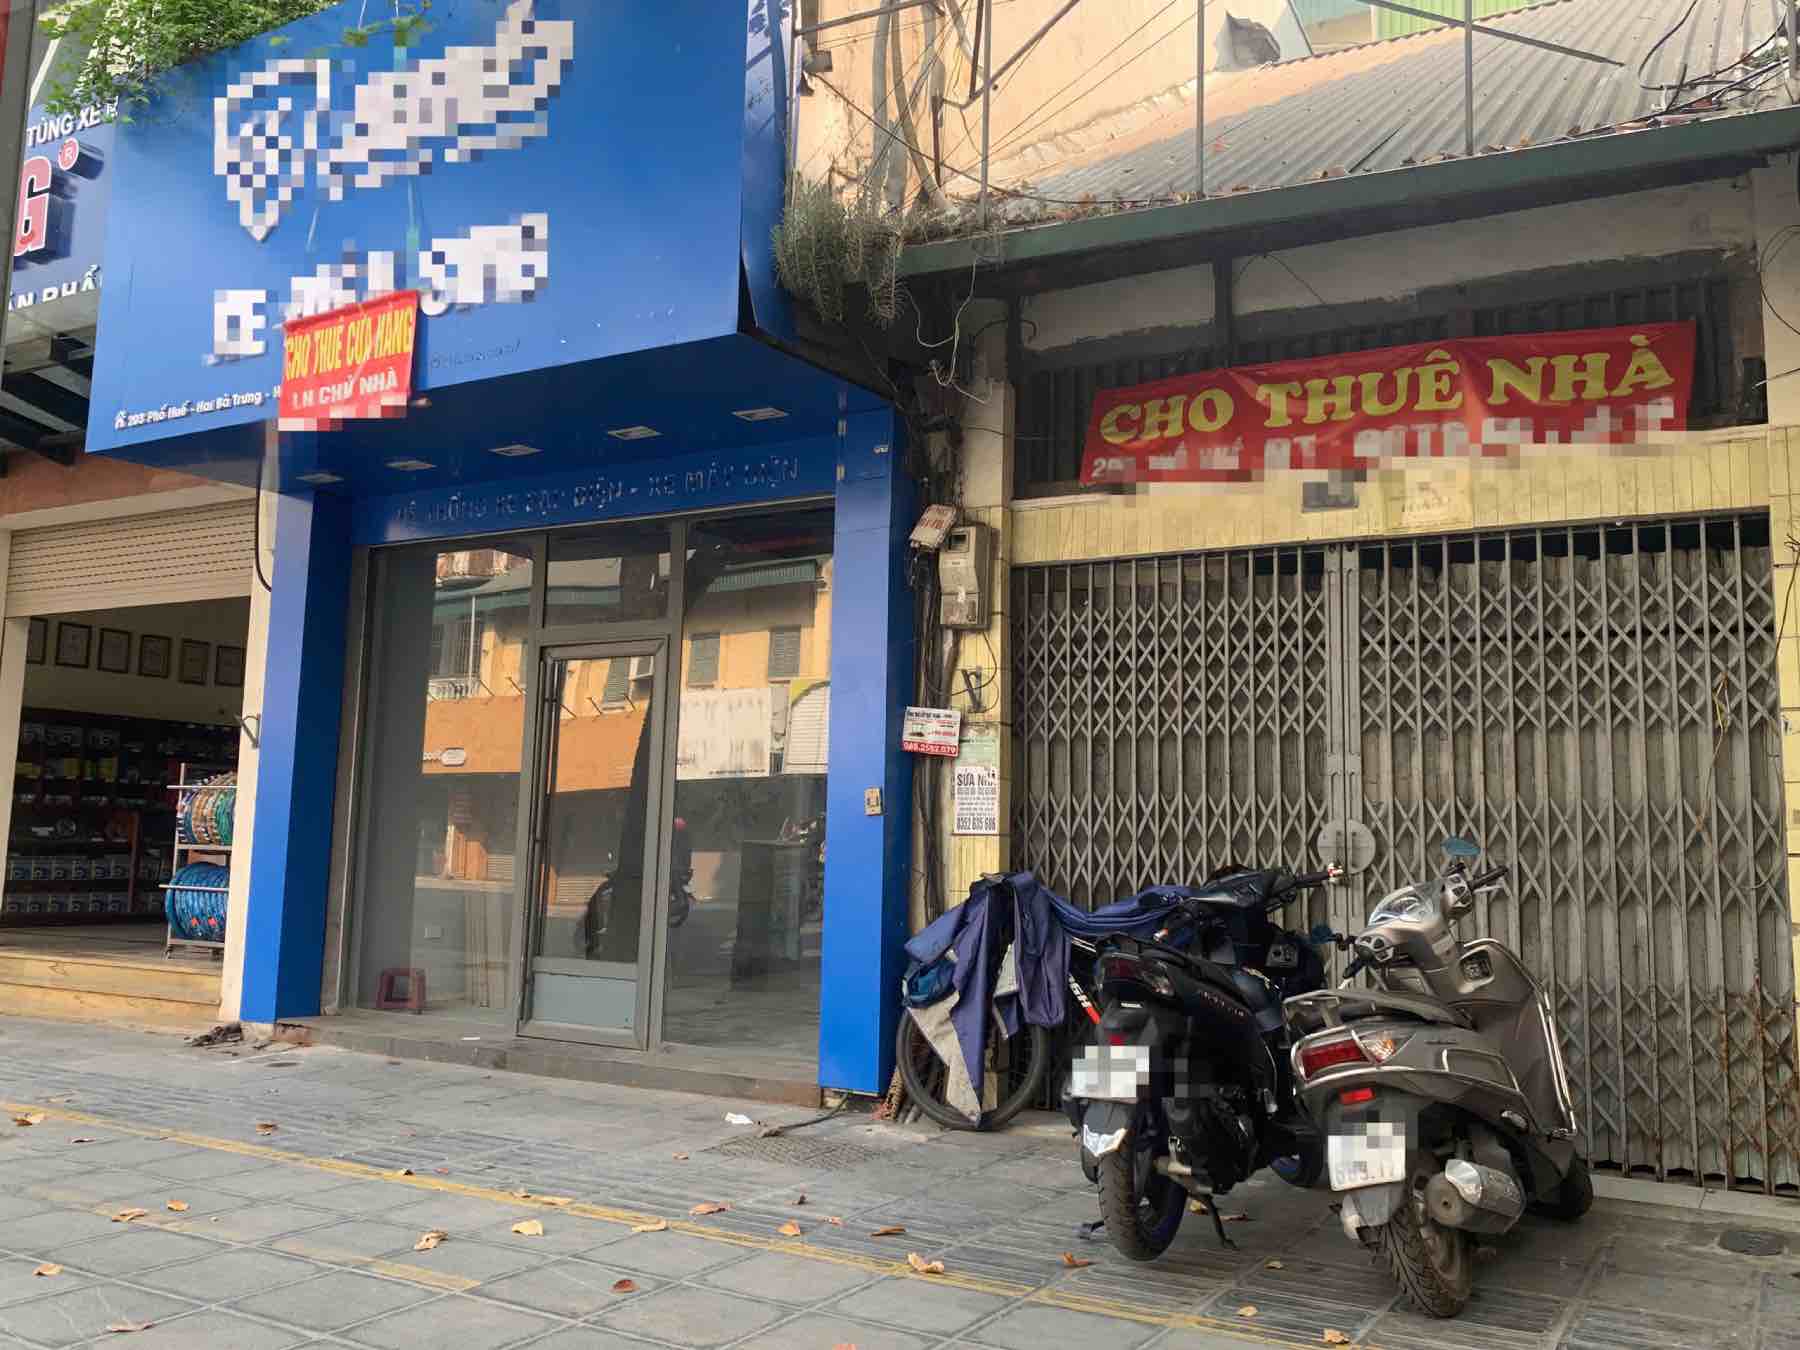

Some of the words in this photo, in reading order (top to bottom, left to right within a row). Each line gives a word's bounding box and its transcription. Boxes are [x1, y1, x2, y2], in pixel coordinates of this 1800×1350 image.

[26, 113, 74, 147] TÙNG
[359, 366, 398, 396] NHÀ
[1099, 388, 1234, 444] CHO
[1255, 349, 1464, 428] THUÊ
[1486, 334, 1676, 407] NHÀ
